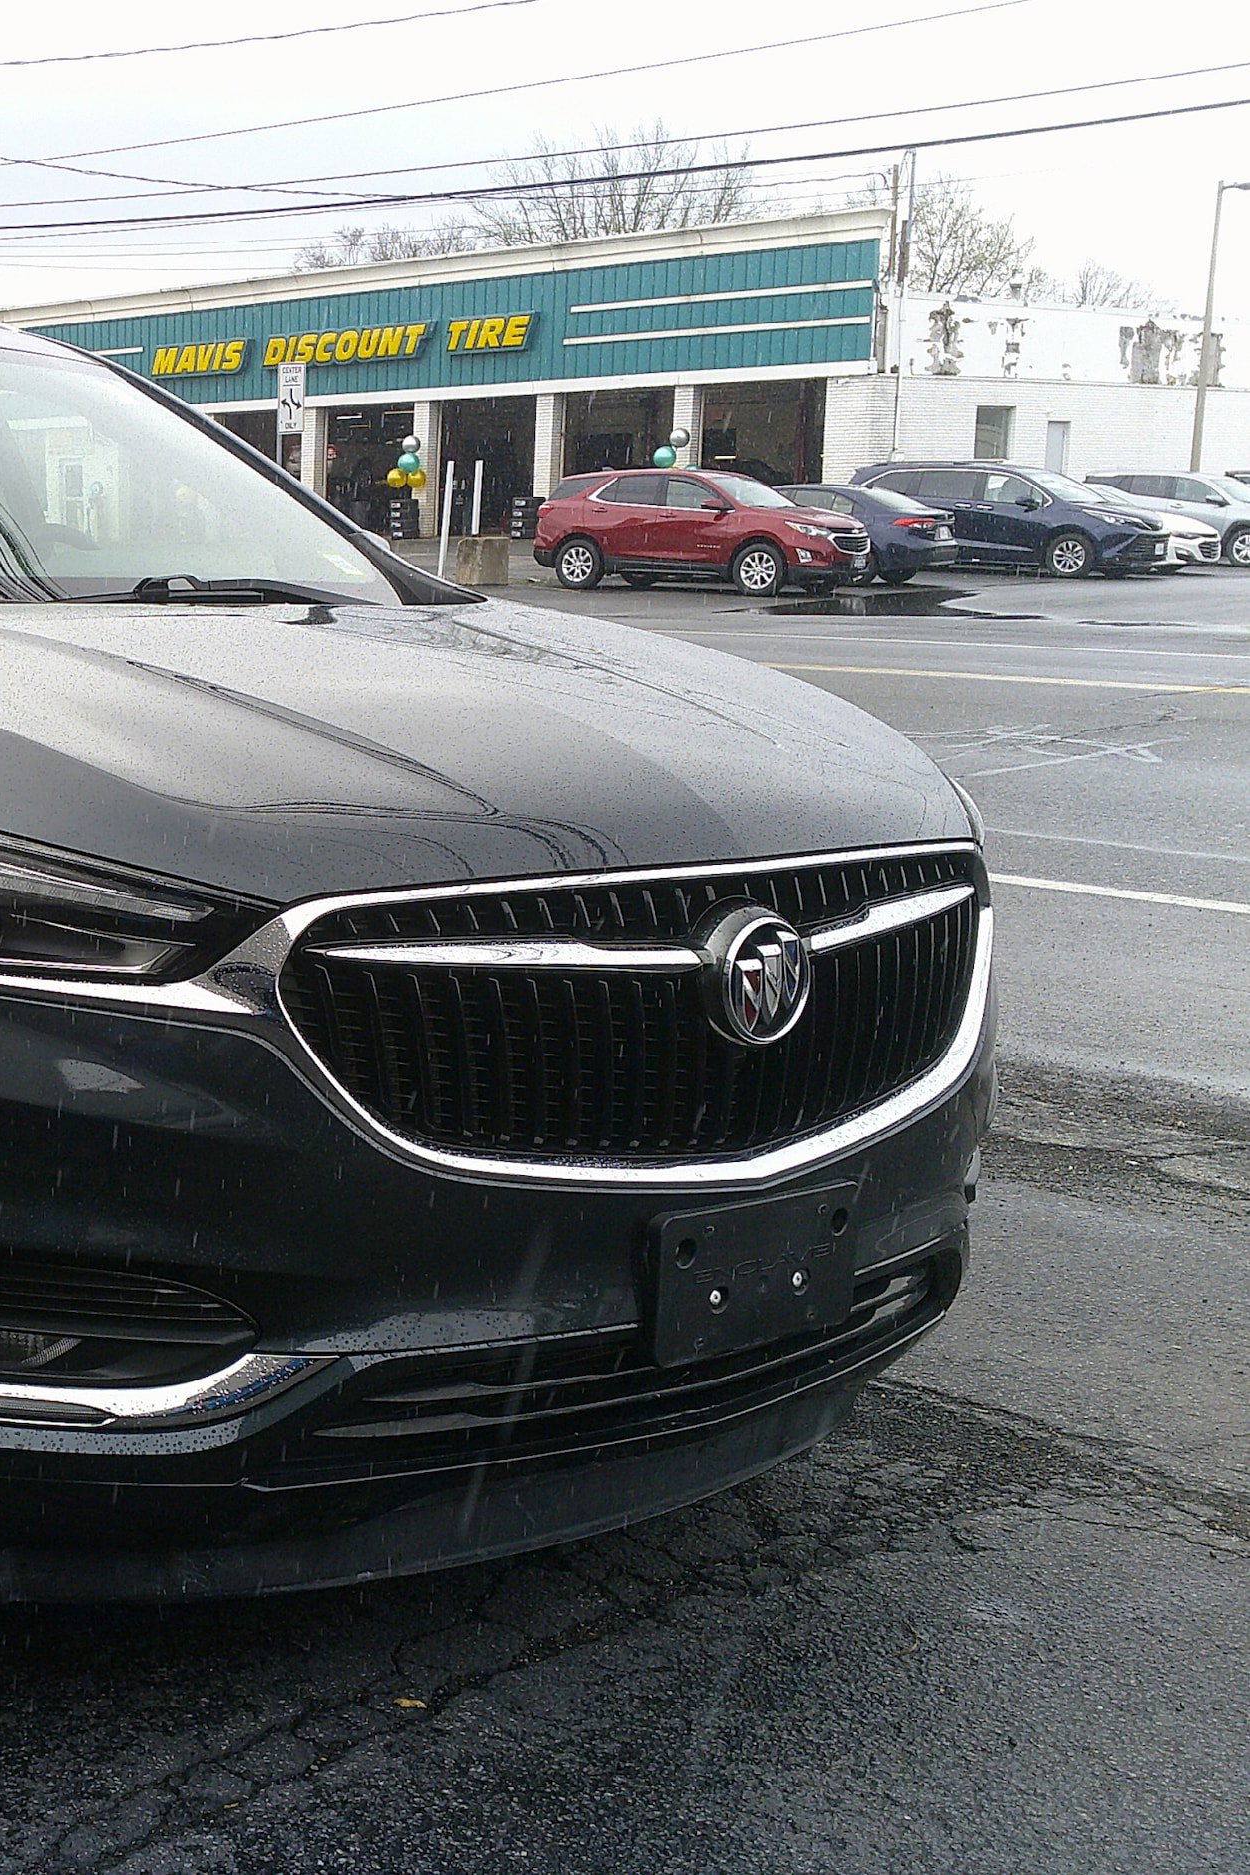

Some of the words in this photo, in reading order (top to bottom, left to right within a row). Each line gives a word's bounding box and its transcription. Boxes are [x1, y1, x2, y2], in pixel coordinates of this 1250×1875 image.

[151, 340, 245, 377] MAVIS
[264, 323, 427, 367] DISCOUNT
[446, 315, 533, 352] TIRE
[282, 366, 303, 374] CENTER
[285, 375, 299, 383] LANE
